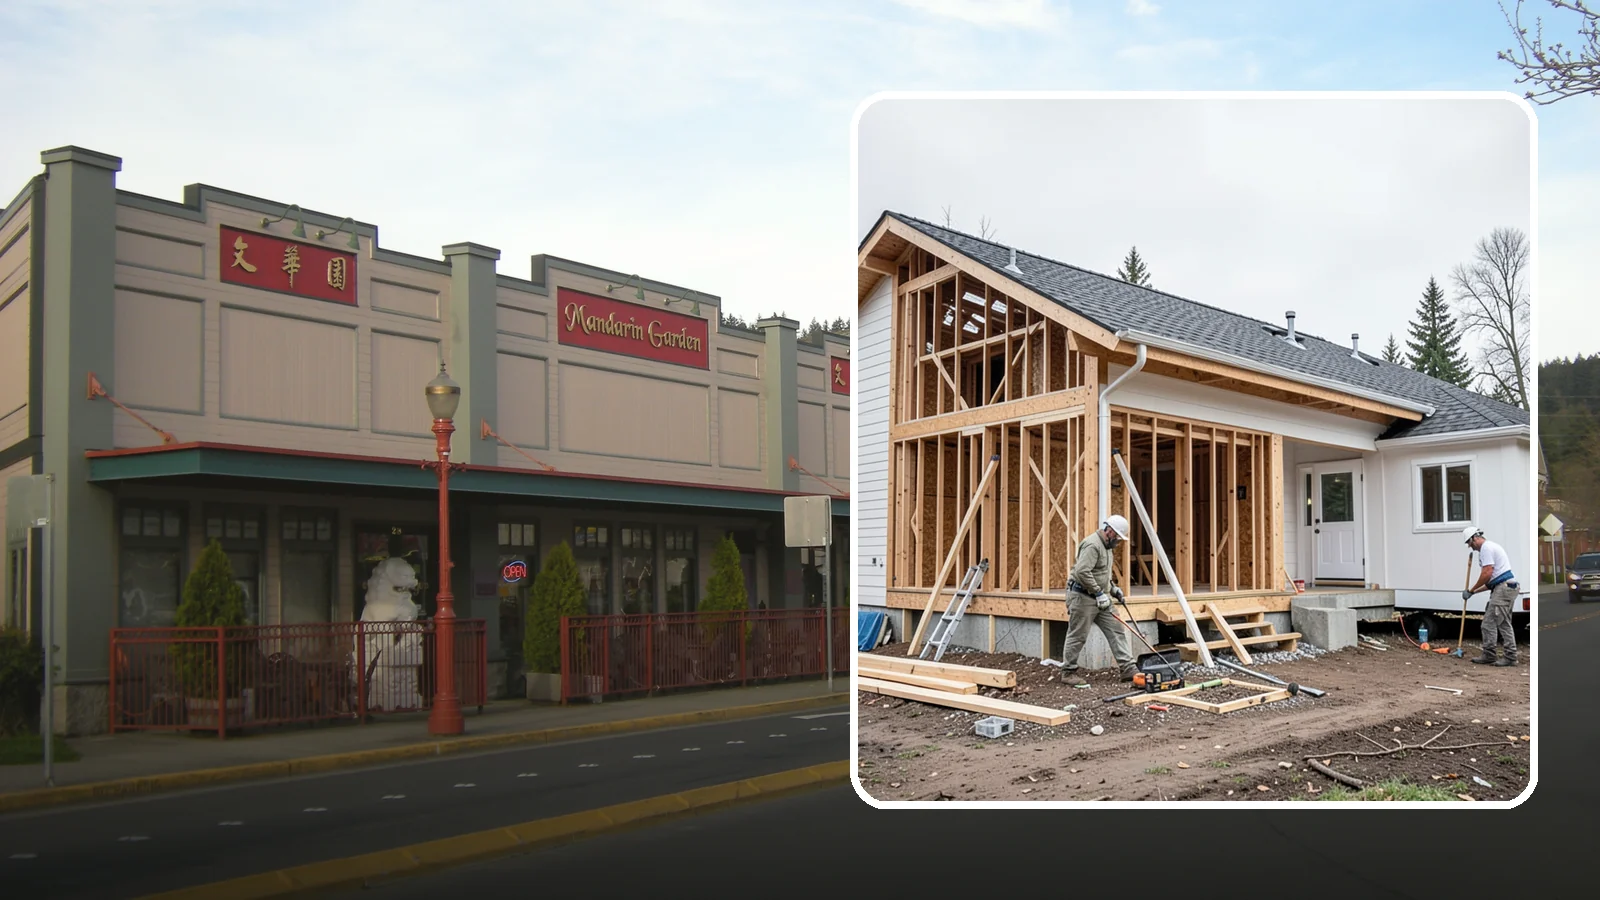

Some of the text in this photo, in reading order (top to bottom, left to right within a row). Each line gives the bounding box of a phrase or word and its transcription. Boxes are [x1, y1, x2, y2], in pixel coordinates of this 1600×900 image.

[564, 302, 701, 352] Mandarin Garden
[503, 565, 527, 578] OPEN
